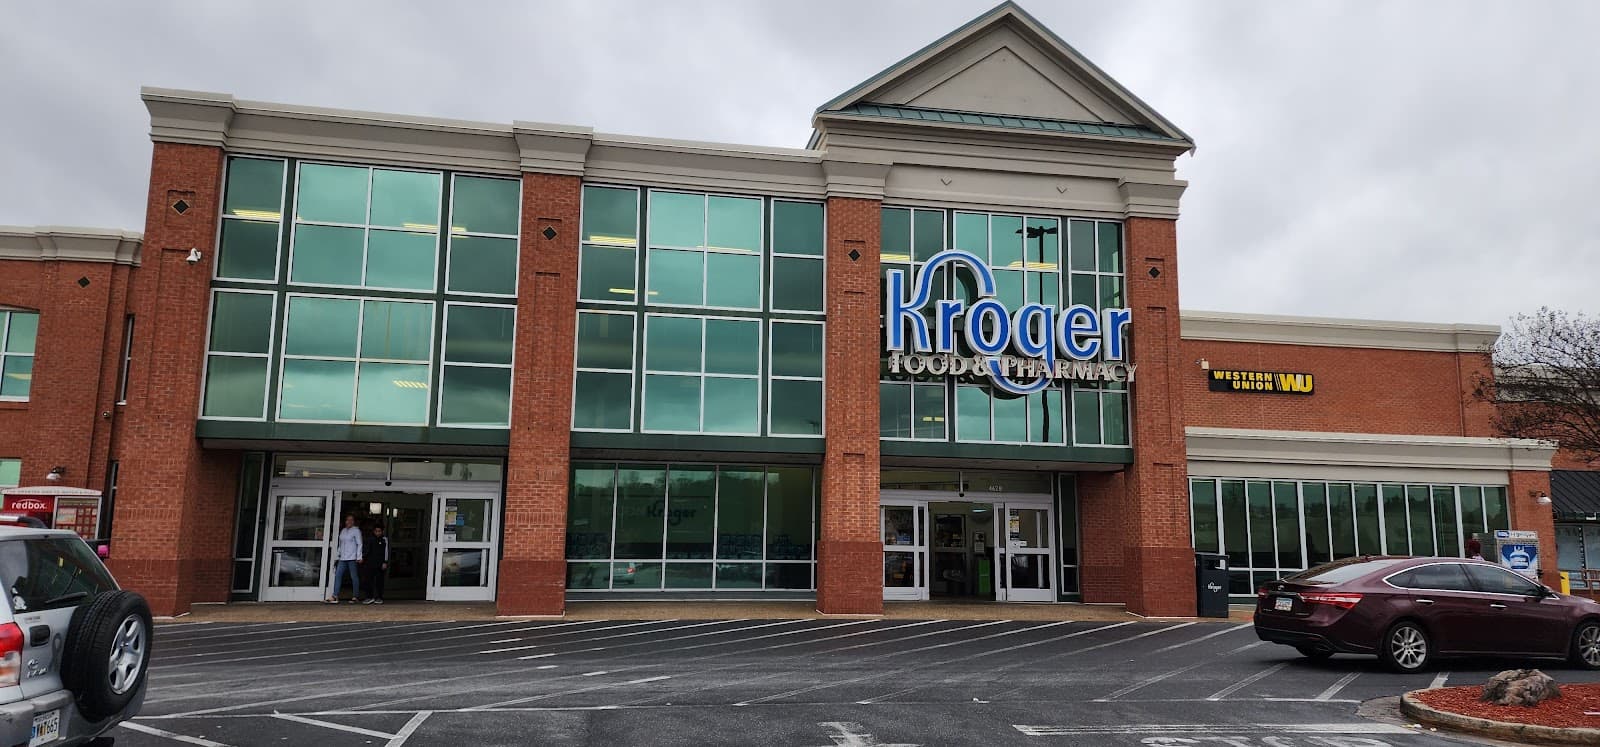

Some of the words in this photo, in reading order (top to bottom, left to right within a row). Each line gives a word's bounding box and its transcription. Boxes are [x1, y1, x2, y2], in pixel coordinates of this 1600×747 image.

[886, 249, 1132, 394] Kroger
[888, 352, 968, 375] FOOD
[972, 355, 992, 377] &
[1000, 354, 1137, 383] PHARMACY
[1213, 370, 1273, 382] WESTERN
[1232, 380, 1273, 391] UNION
[1279, 373, 1313, 393] WU
[647, 500, 697, 526] Krger
